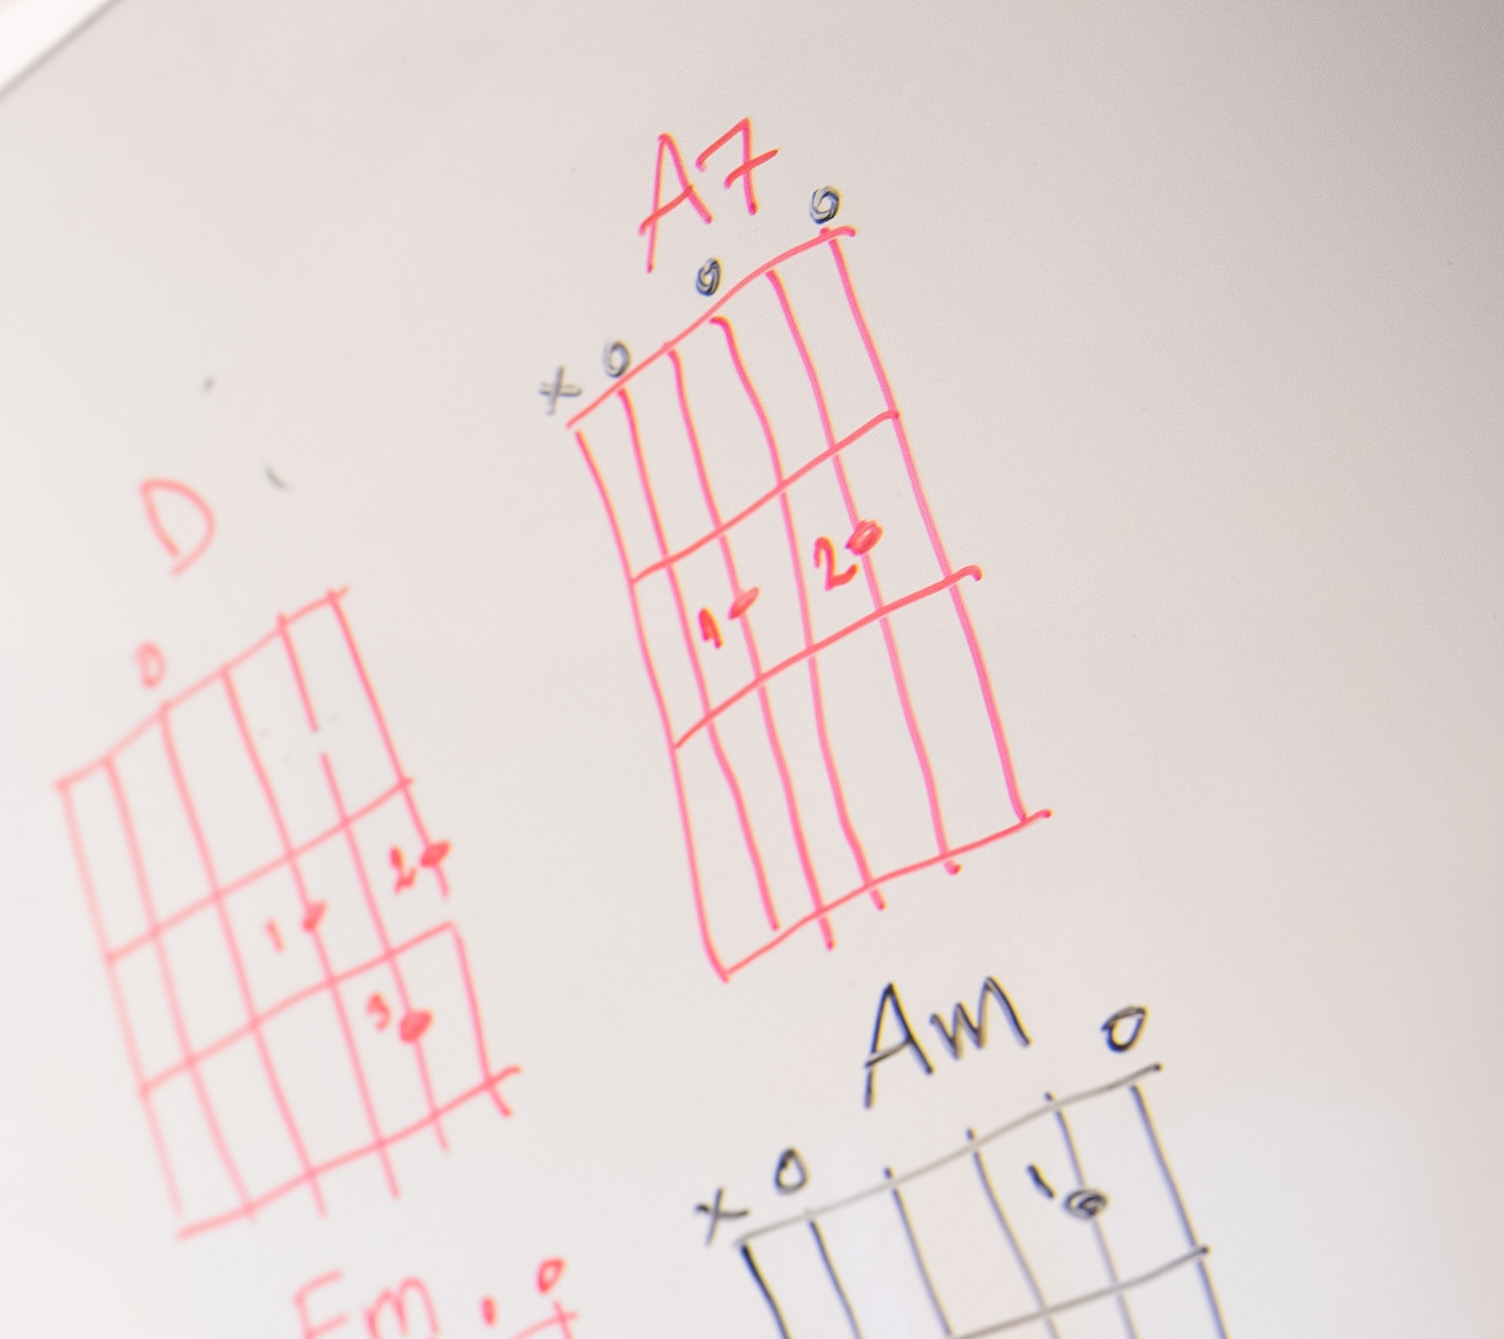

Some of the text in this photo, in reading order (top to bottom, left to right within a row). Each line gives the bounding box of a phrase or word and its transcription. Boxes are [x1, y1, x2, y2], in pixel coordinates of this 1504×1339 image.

[639, 115, 779, 273] A7
[138, 476, 217, 577] D
[813, 535, 859, 591] 2
